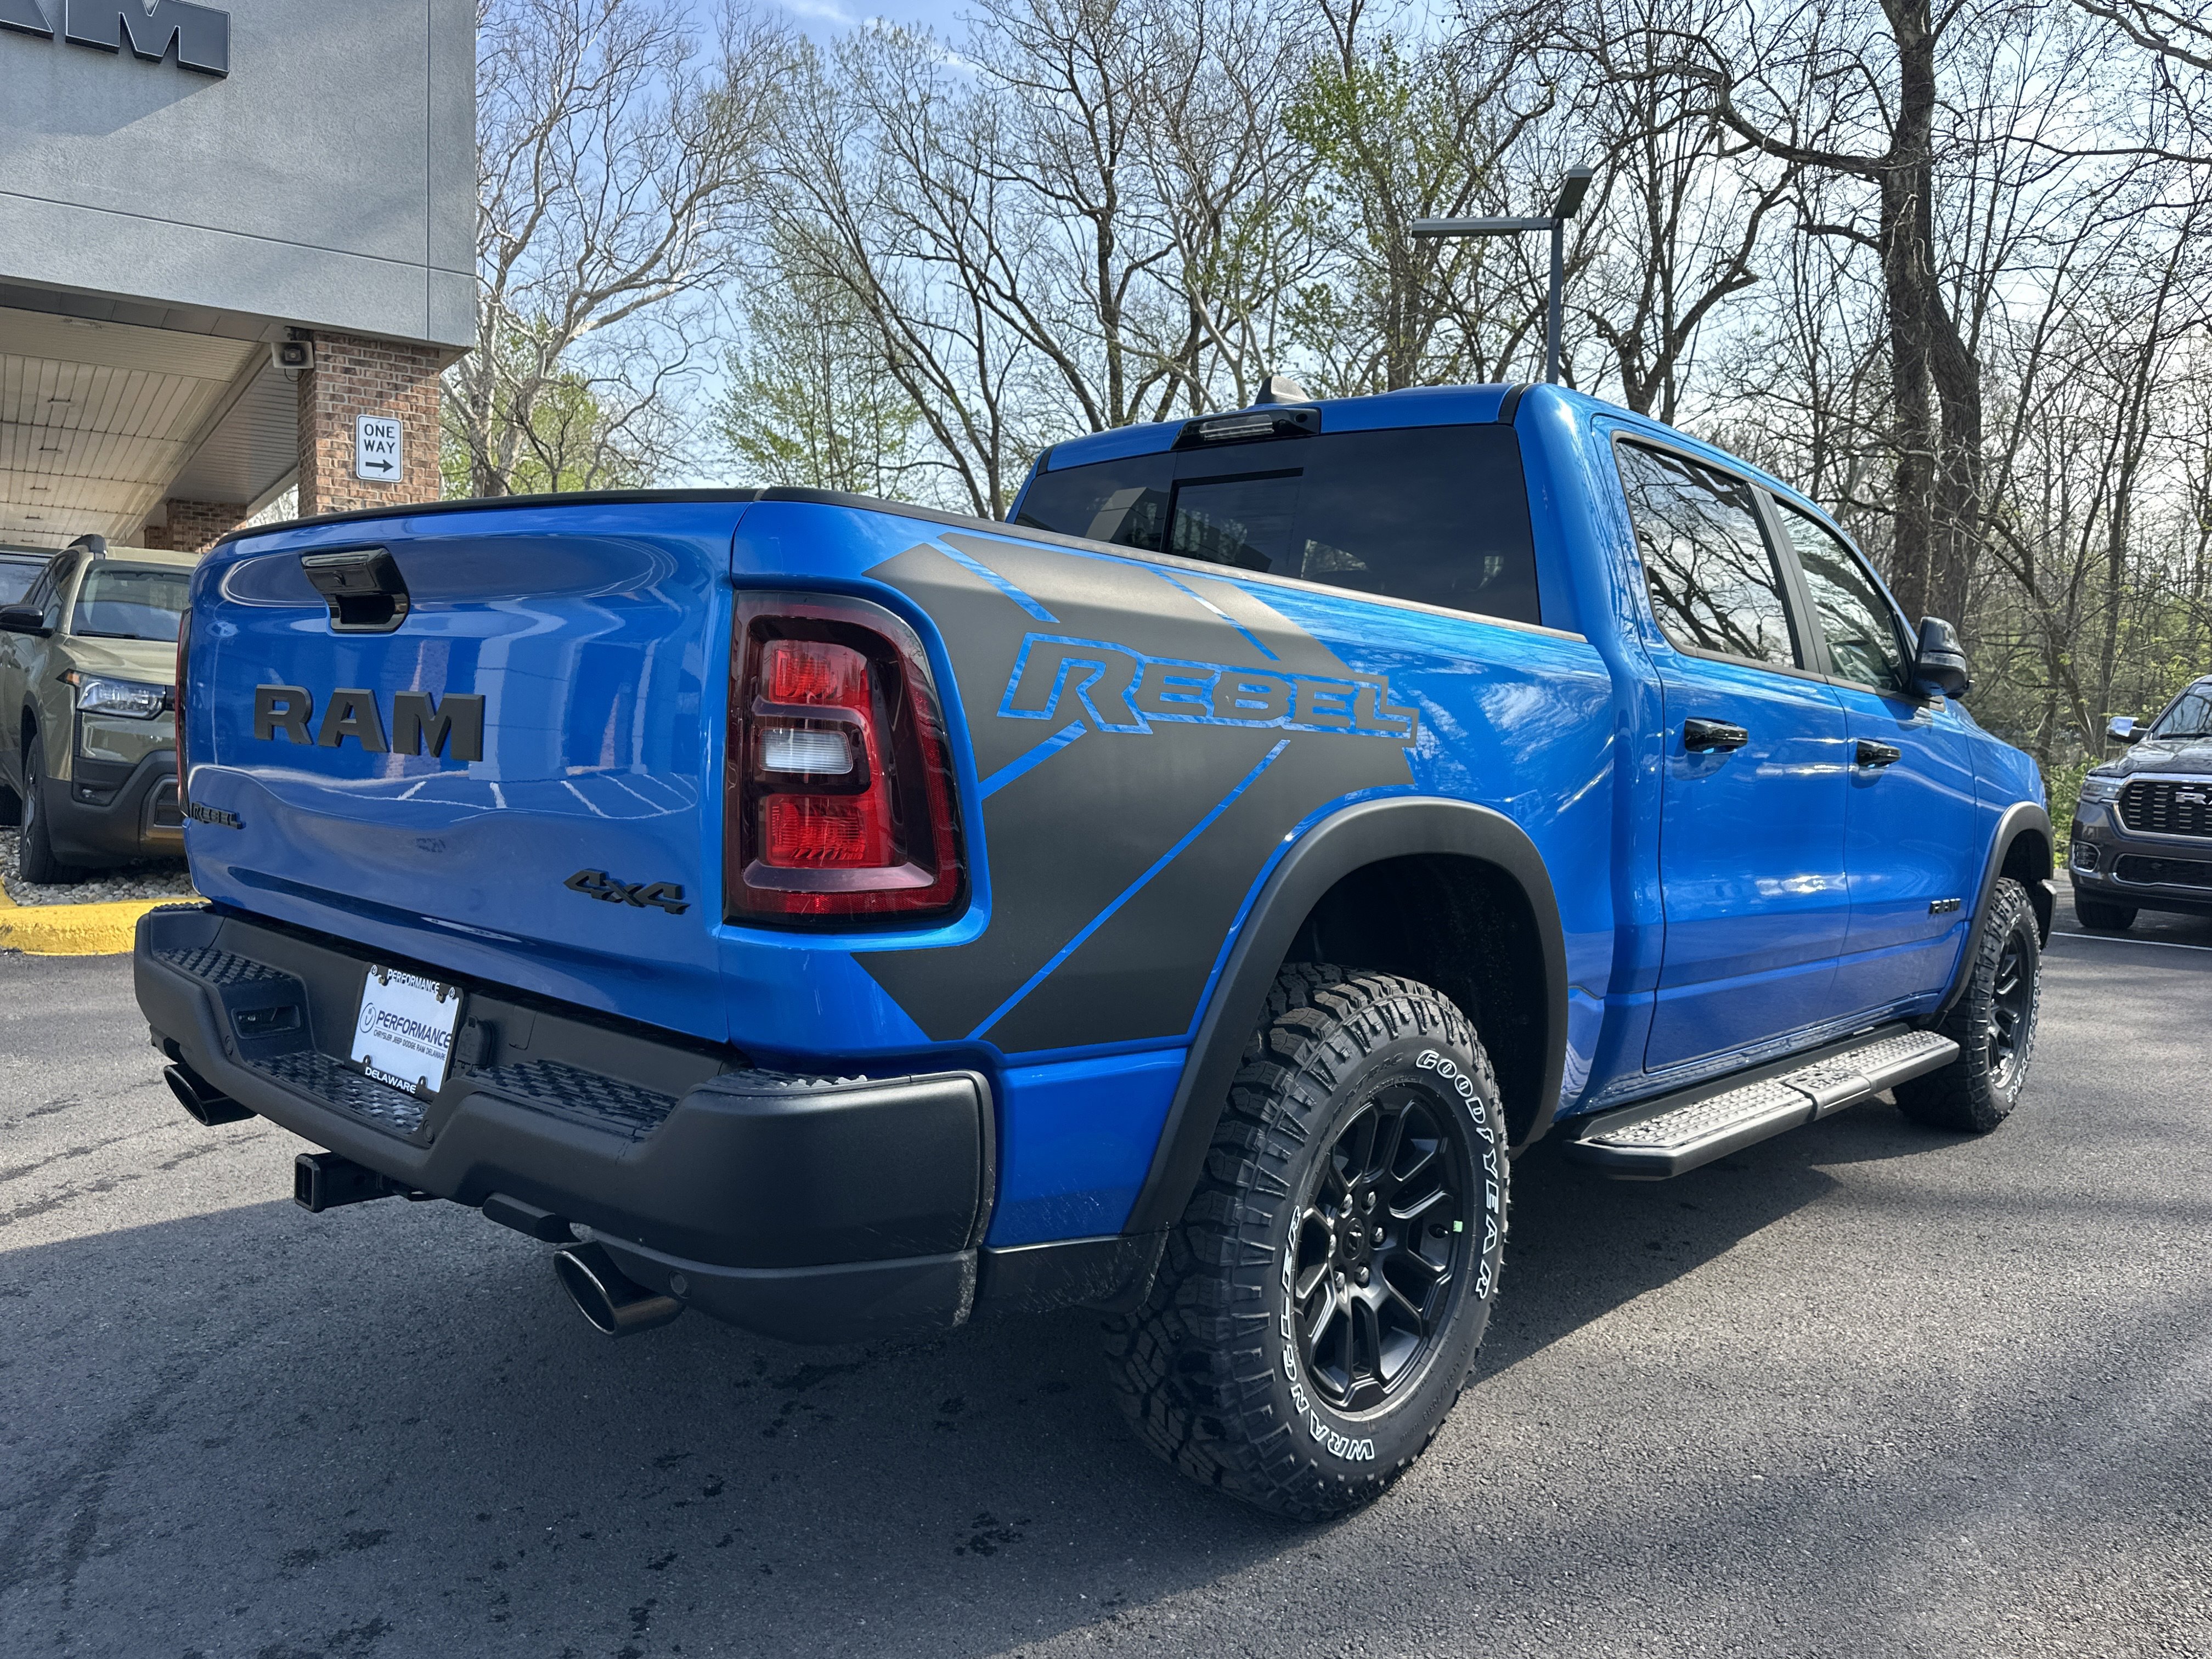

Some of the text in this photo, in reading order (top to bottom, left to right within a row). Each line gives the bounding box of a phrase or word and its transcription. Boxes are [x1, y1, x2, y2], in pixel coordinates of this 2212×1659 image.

[0, 0, 230, 78] M
[364, 424, 395, 438] ONE
[364, 439, 396, 454] WAY
[996, 632, 1417, 740] REBEL
[254, 684, 486, 761] RAM
[2175, 792, 2212, 805] R
[191, 802, 245, 830] REBEL
[1928, 898, 1961, 914] RAM
[387, 968, 440, 994] PERFORMANCE
[376, 1009, 452, 1049] PERFORMANCE
[373, 1029, 446, 1062] CHRYSLER JEEP DODGE RAM DELAWARE
[365, 1066, 417, 1094] DELAWARE
[1415, 1049, 1500, 1300] GOODYEAR
[1279, 1205, 1375, 1462] WRANGLER
